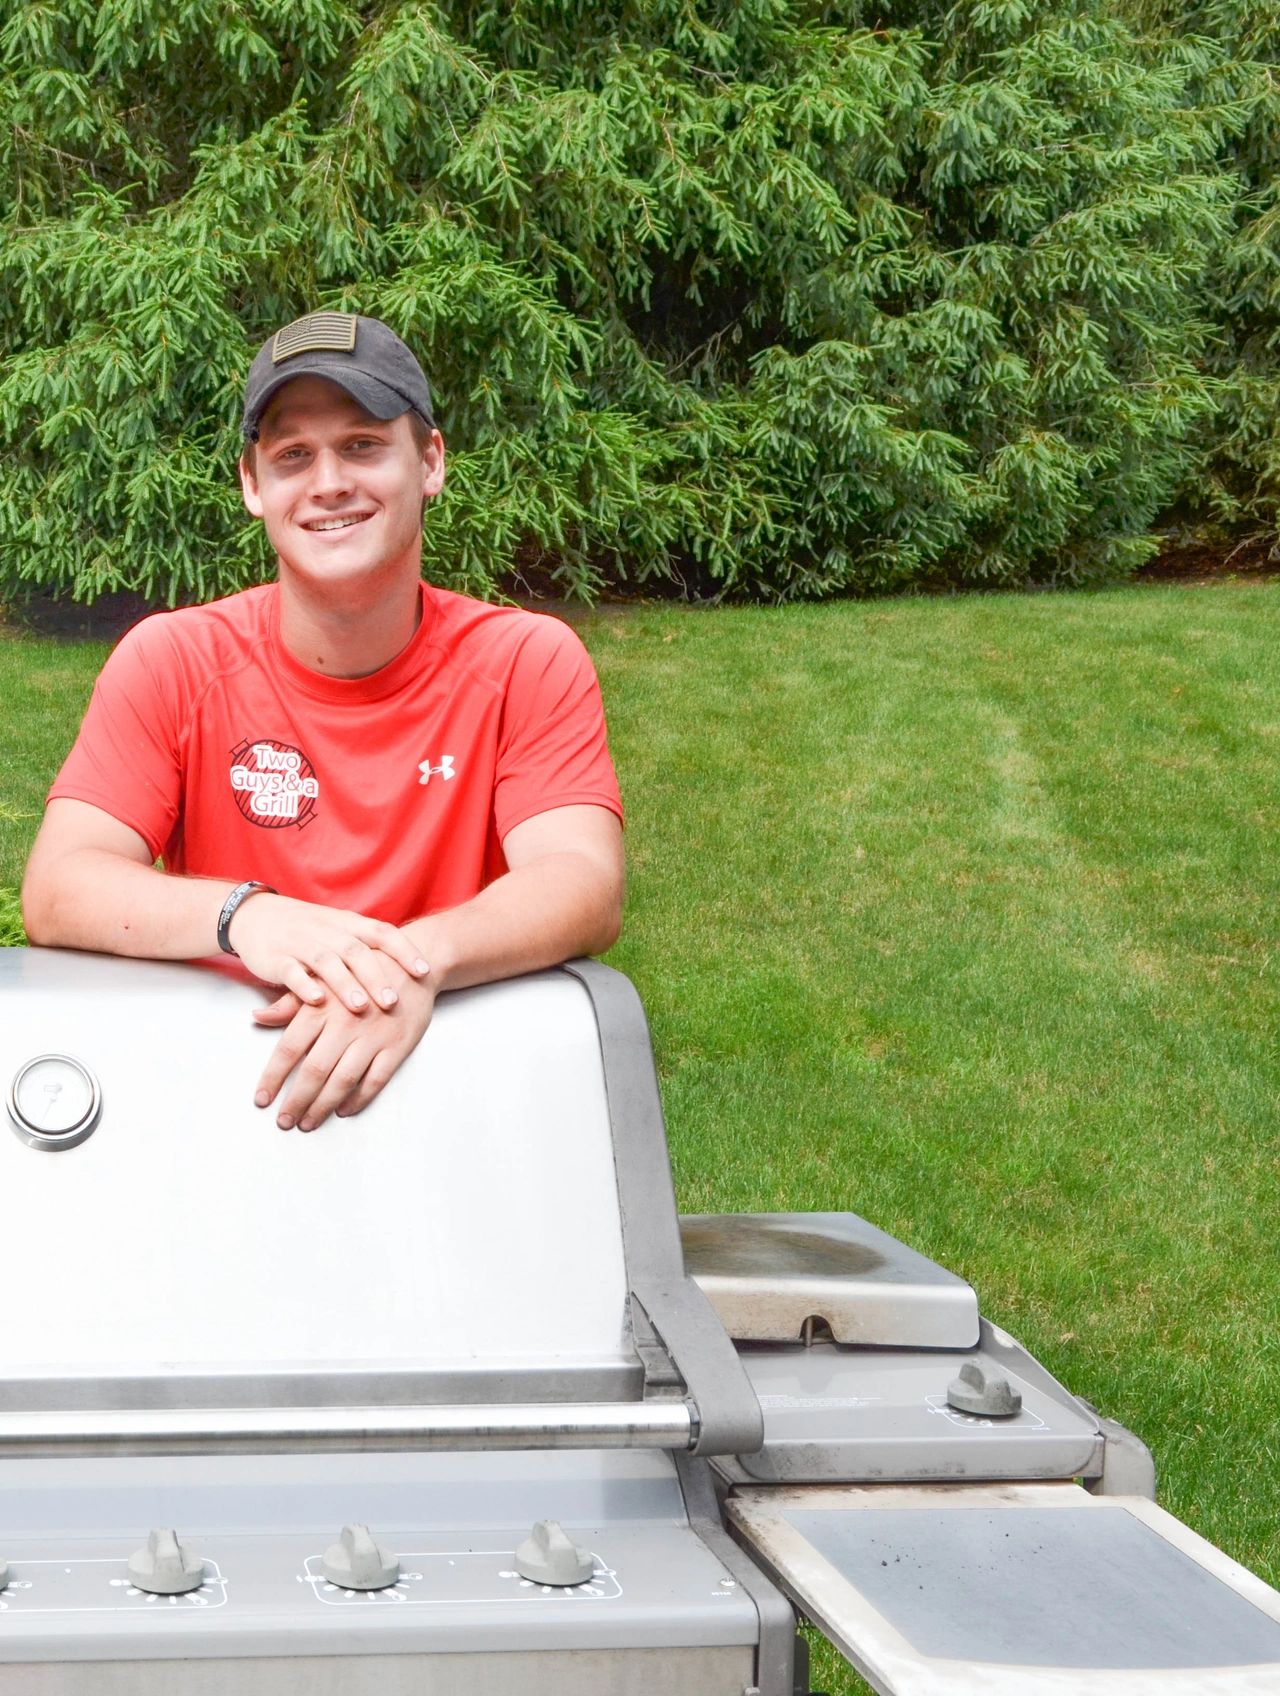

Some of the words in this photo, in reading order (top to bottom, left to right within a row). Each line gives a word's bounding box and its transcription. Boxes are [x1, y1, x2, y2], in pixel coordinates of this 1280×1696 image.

[255, 746, 299, 770] Two
[231, 767, 281, 794] Guys
[285, 772, 301, 793] &
[304, 779, 317, 796] a
[252, 793, 296, 815] Grill
